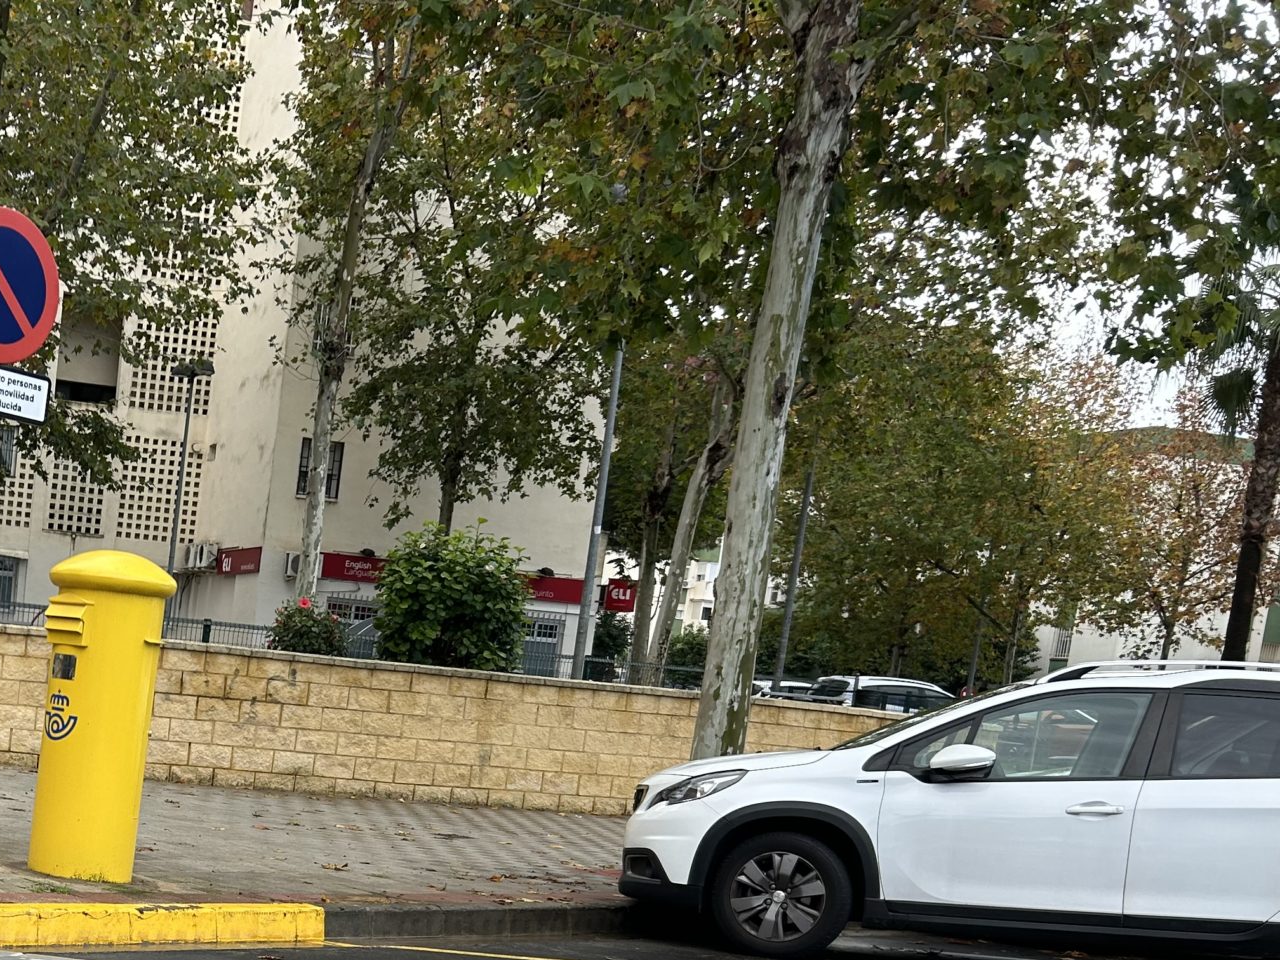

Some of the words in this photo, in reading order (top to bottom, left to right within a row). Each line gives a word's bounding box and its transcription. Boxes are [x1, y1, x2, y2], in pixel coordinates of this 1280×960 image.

[7, 377, 42, 392] personas
[345, 560, 372, 570] English
[344, 568, 376, 578] Langu
[610, 586, 631, 600] ELI
